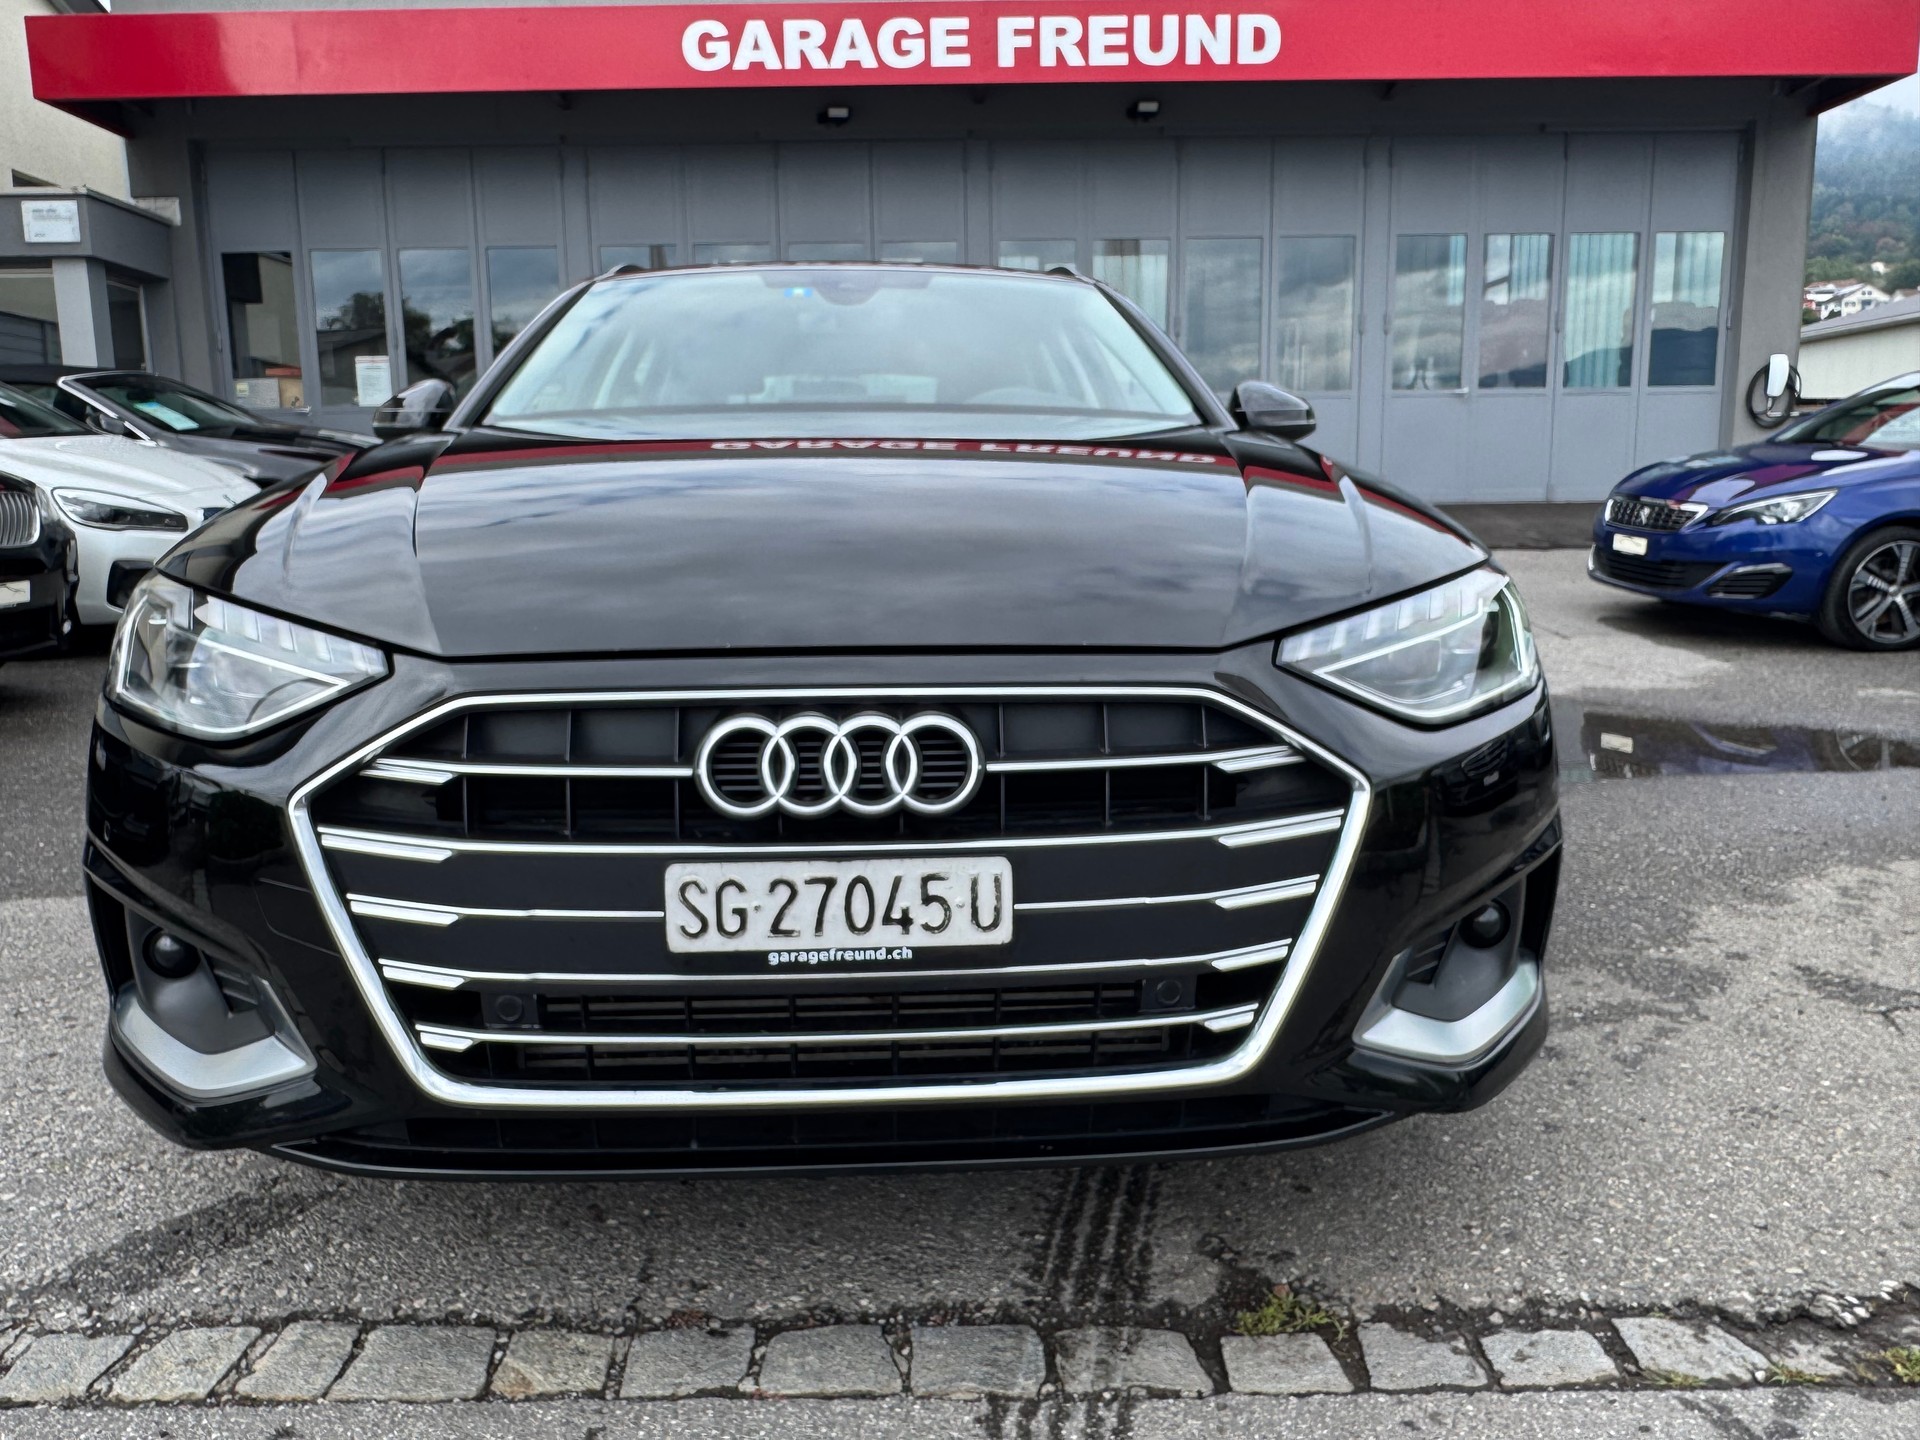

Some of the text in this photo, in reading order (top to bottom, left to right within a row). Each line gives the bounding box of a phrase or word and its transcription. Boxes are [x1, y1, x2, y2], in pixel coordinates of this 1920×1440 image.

[681, 14, 1282, 71] GARAGE FREUND
[767, 946, 913, 966] garagefreund.ch
